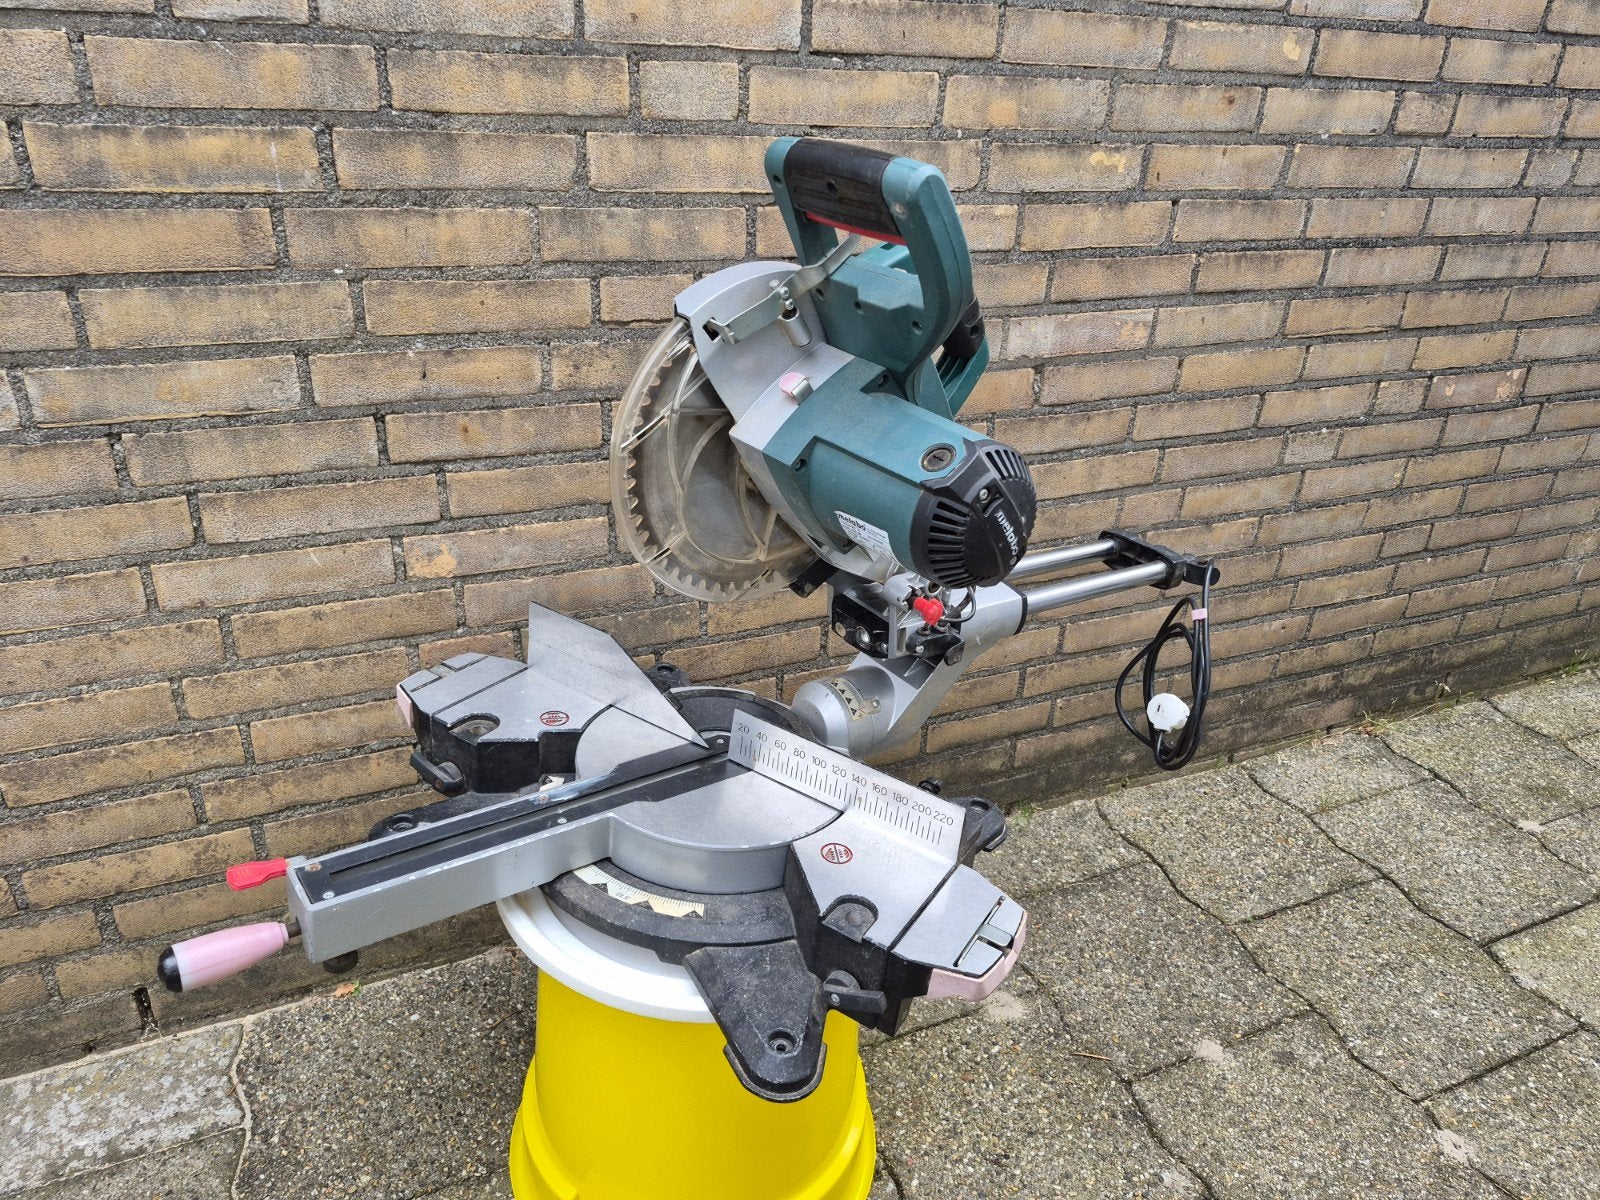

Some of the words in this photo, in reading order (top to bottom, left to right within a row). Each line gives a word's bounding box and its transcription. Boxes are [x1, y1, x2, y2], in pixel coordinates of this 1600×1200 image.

[995, 509, 1018, 556] metabo
[738, 722, 750, 734] 20
[756, 731, 768, 742] 40
[774, 739, 787, 751] 60
[793, 747, 806, 759] 80
[812, 755, 827, 769] 100
[831, 764, 847, 778] 120
[851, 773, 867, 787] 140
[872, 782, 888, 796] 160
[893, 792, 909, 806] 180
[911, 801, 932, 816] 200
[933, 810, 954, 826] 220
